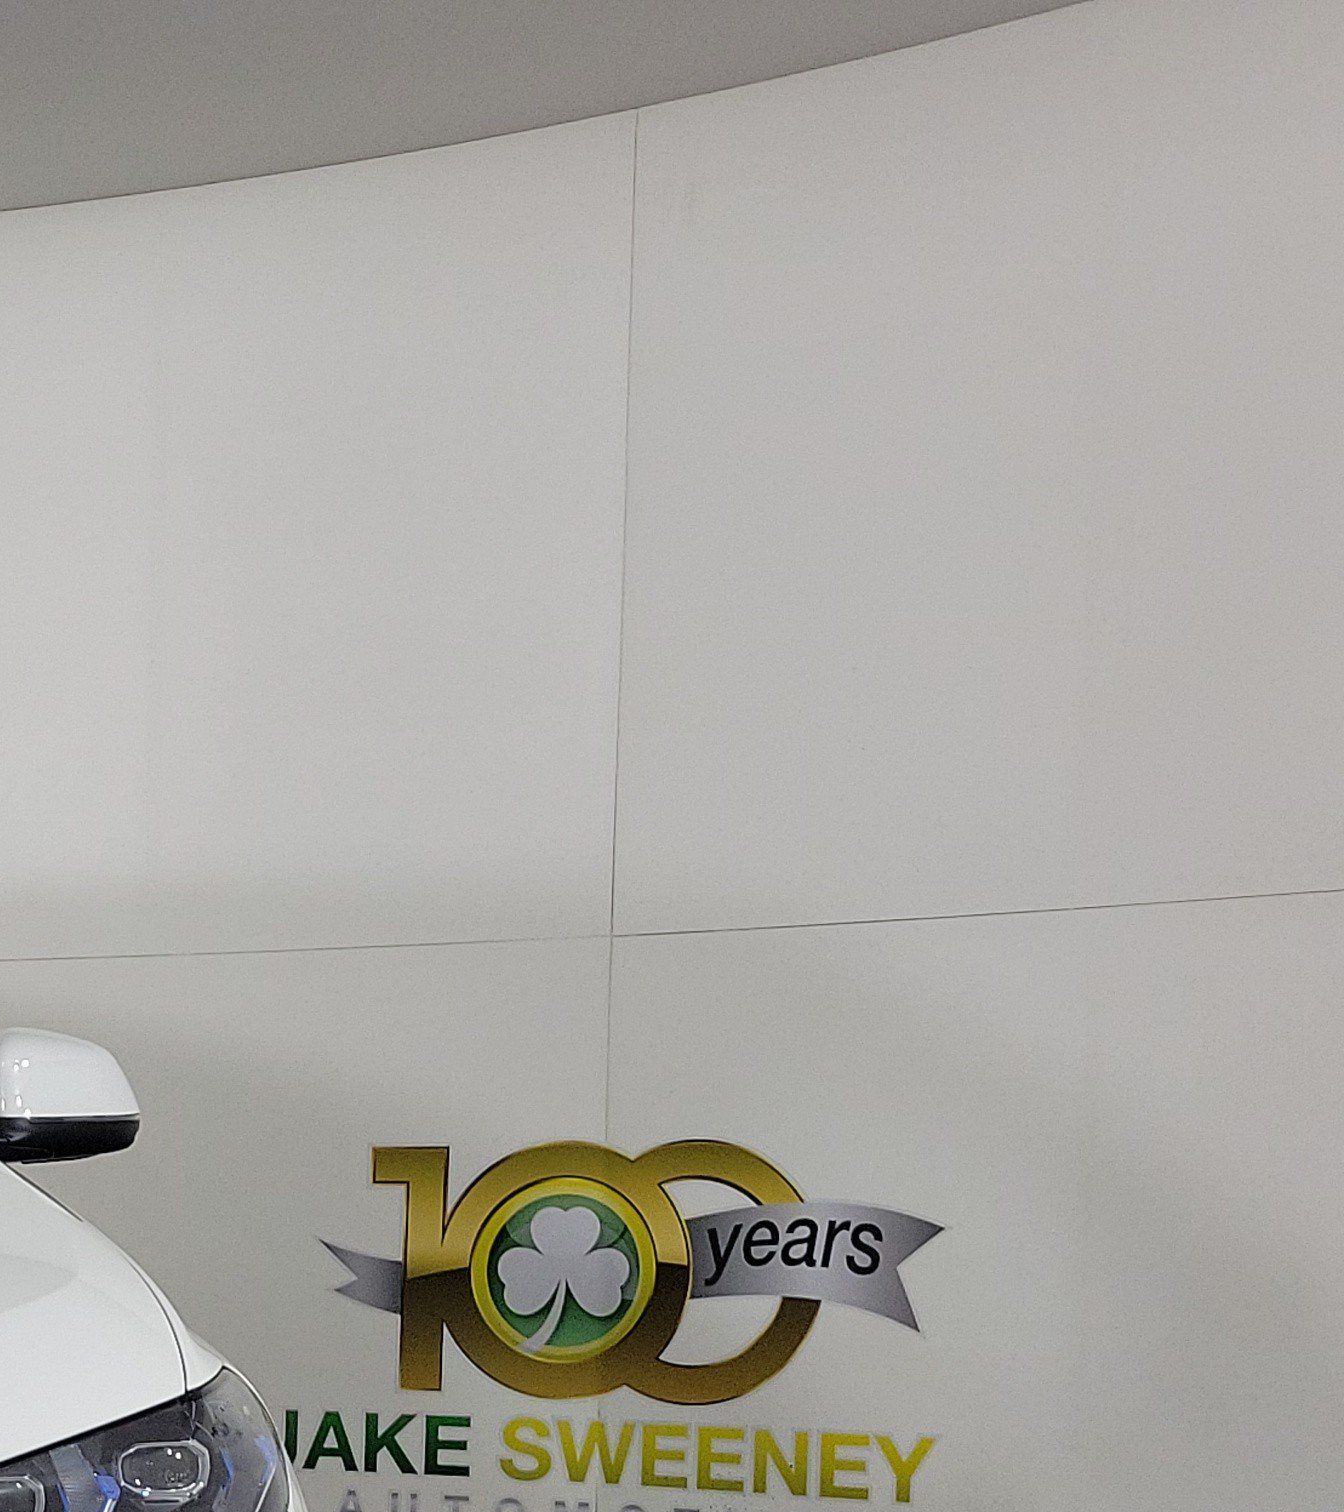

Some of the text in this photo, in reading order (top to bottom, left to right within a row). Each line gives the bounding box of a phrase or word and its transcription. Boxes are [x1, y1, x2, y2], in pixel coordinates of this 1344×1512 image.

[371, 1138, 822, 1405] 100
[703, 1216, 883, 1286] years
[498, 1416, 936, 1503] SWEENEY
